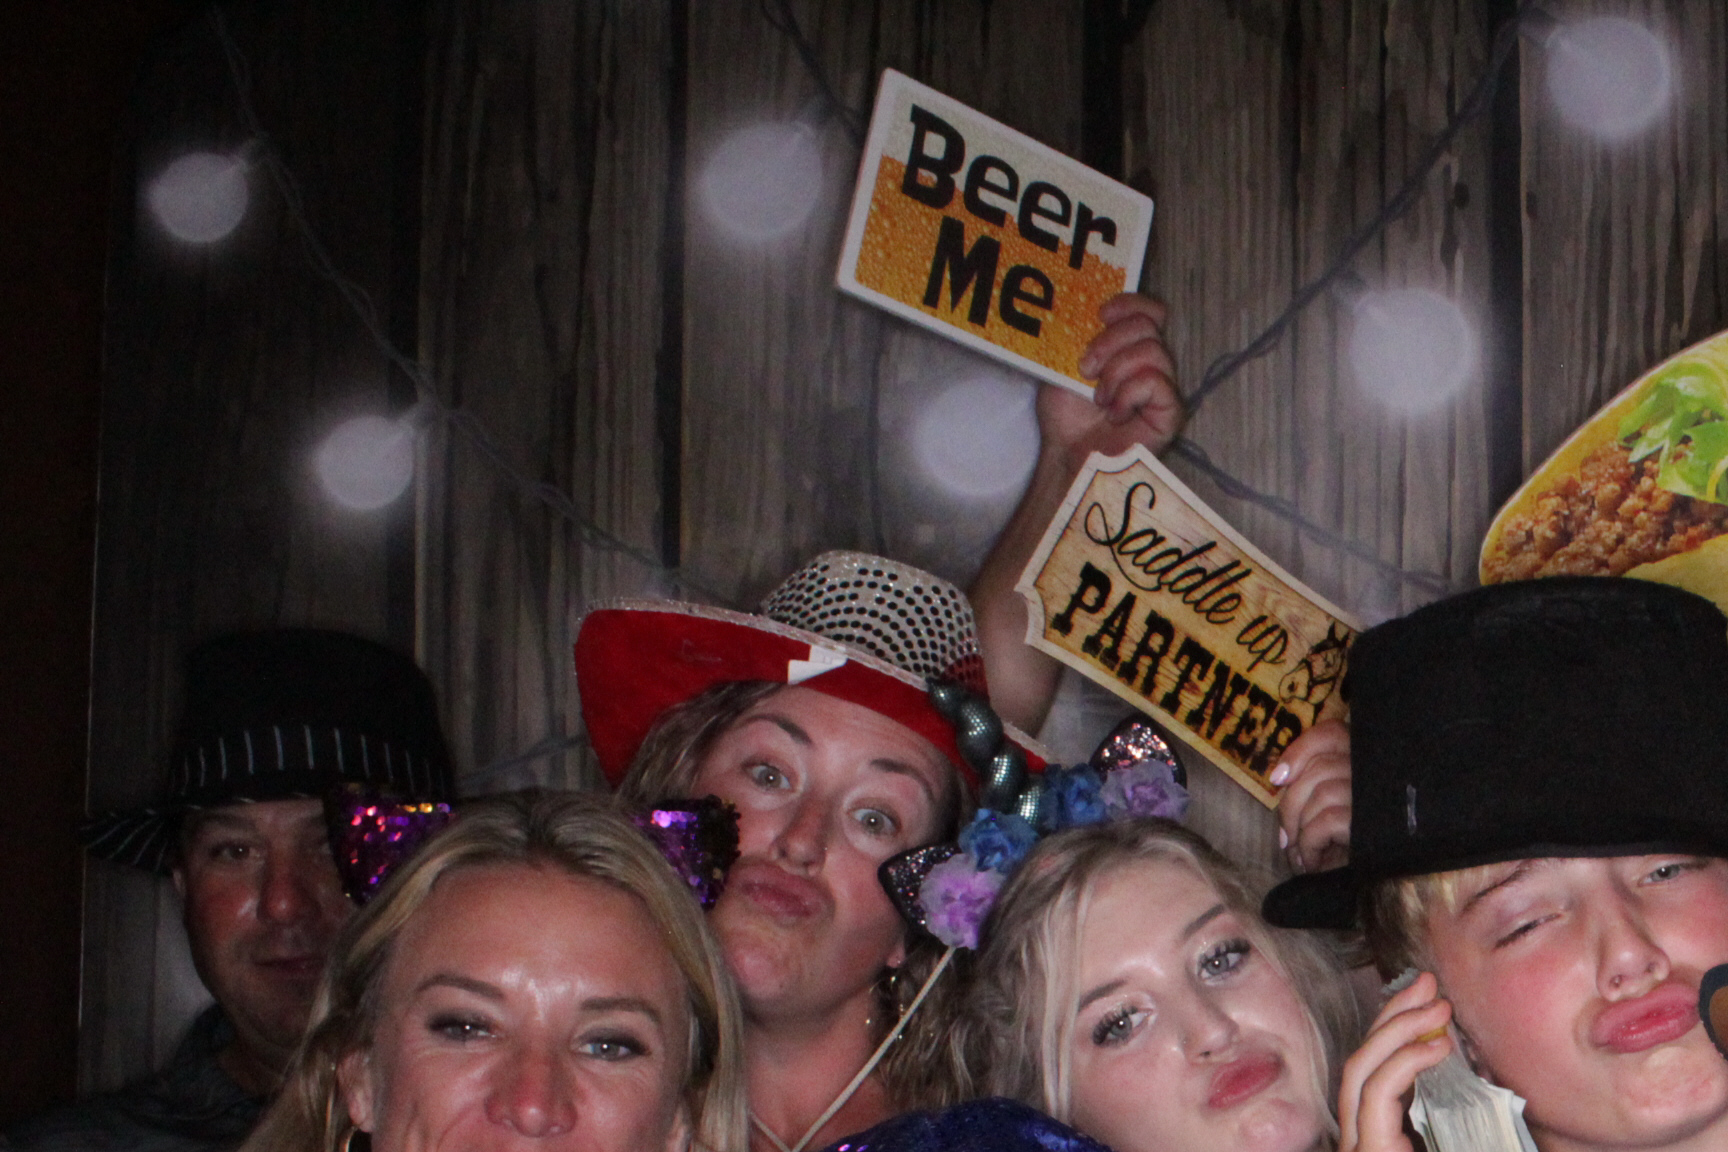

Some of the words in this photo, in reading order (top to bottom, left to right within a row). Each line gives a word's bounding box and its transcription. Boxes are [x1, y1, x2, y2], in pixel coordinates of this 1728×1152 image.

[901, 103, 1117, 270] Beer
[923, 215, 1055, 338] Me
[1084, 482, 1252, 624] Saddle
[1237, 615, 1290, 673] up
[1050, 561, 1304, 777] PARTNER
